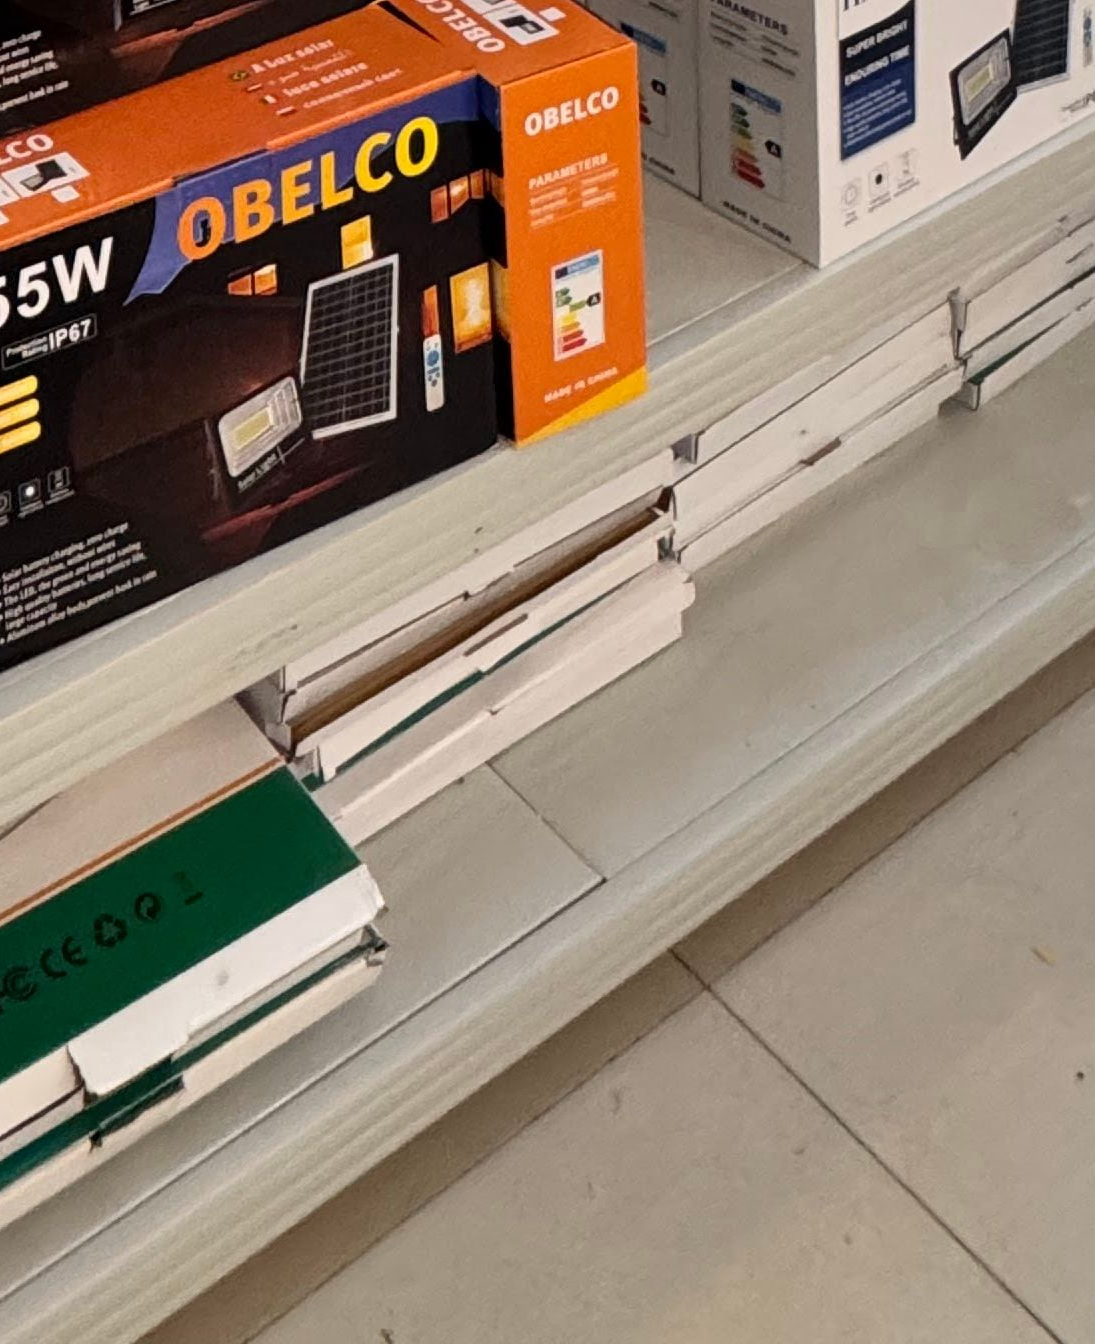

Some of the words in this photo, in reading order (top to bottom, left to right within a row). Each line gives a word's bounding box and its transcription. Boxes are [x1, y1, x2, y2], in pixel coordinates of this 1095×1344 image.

[524, 85, 620, 138] OBELCO
[176, 115, 441, 263] OBELCO
[527, 152, 609, 191] PARAMETERS
[48, 317, 92, 352] IP67
